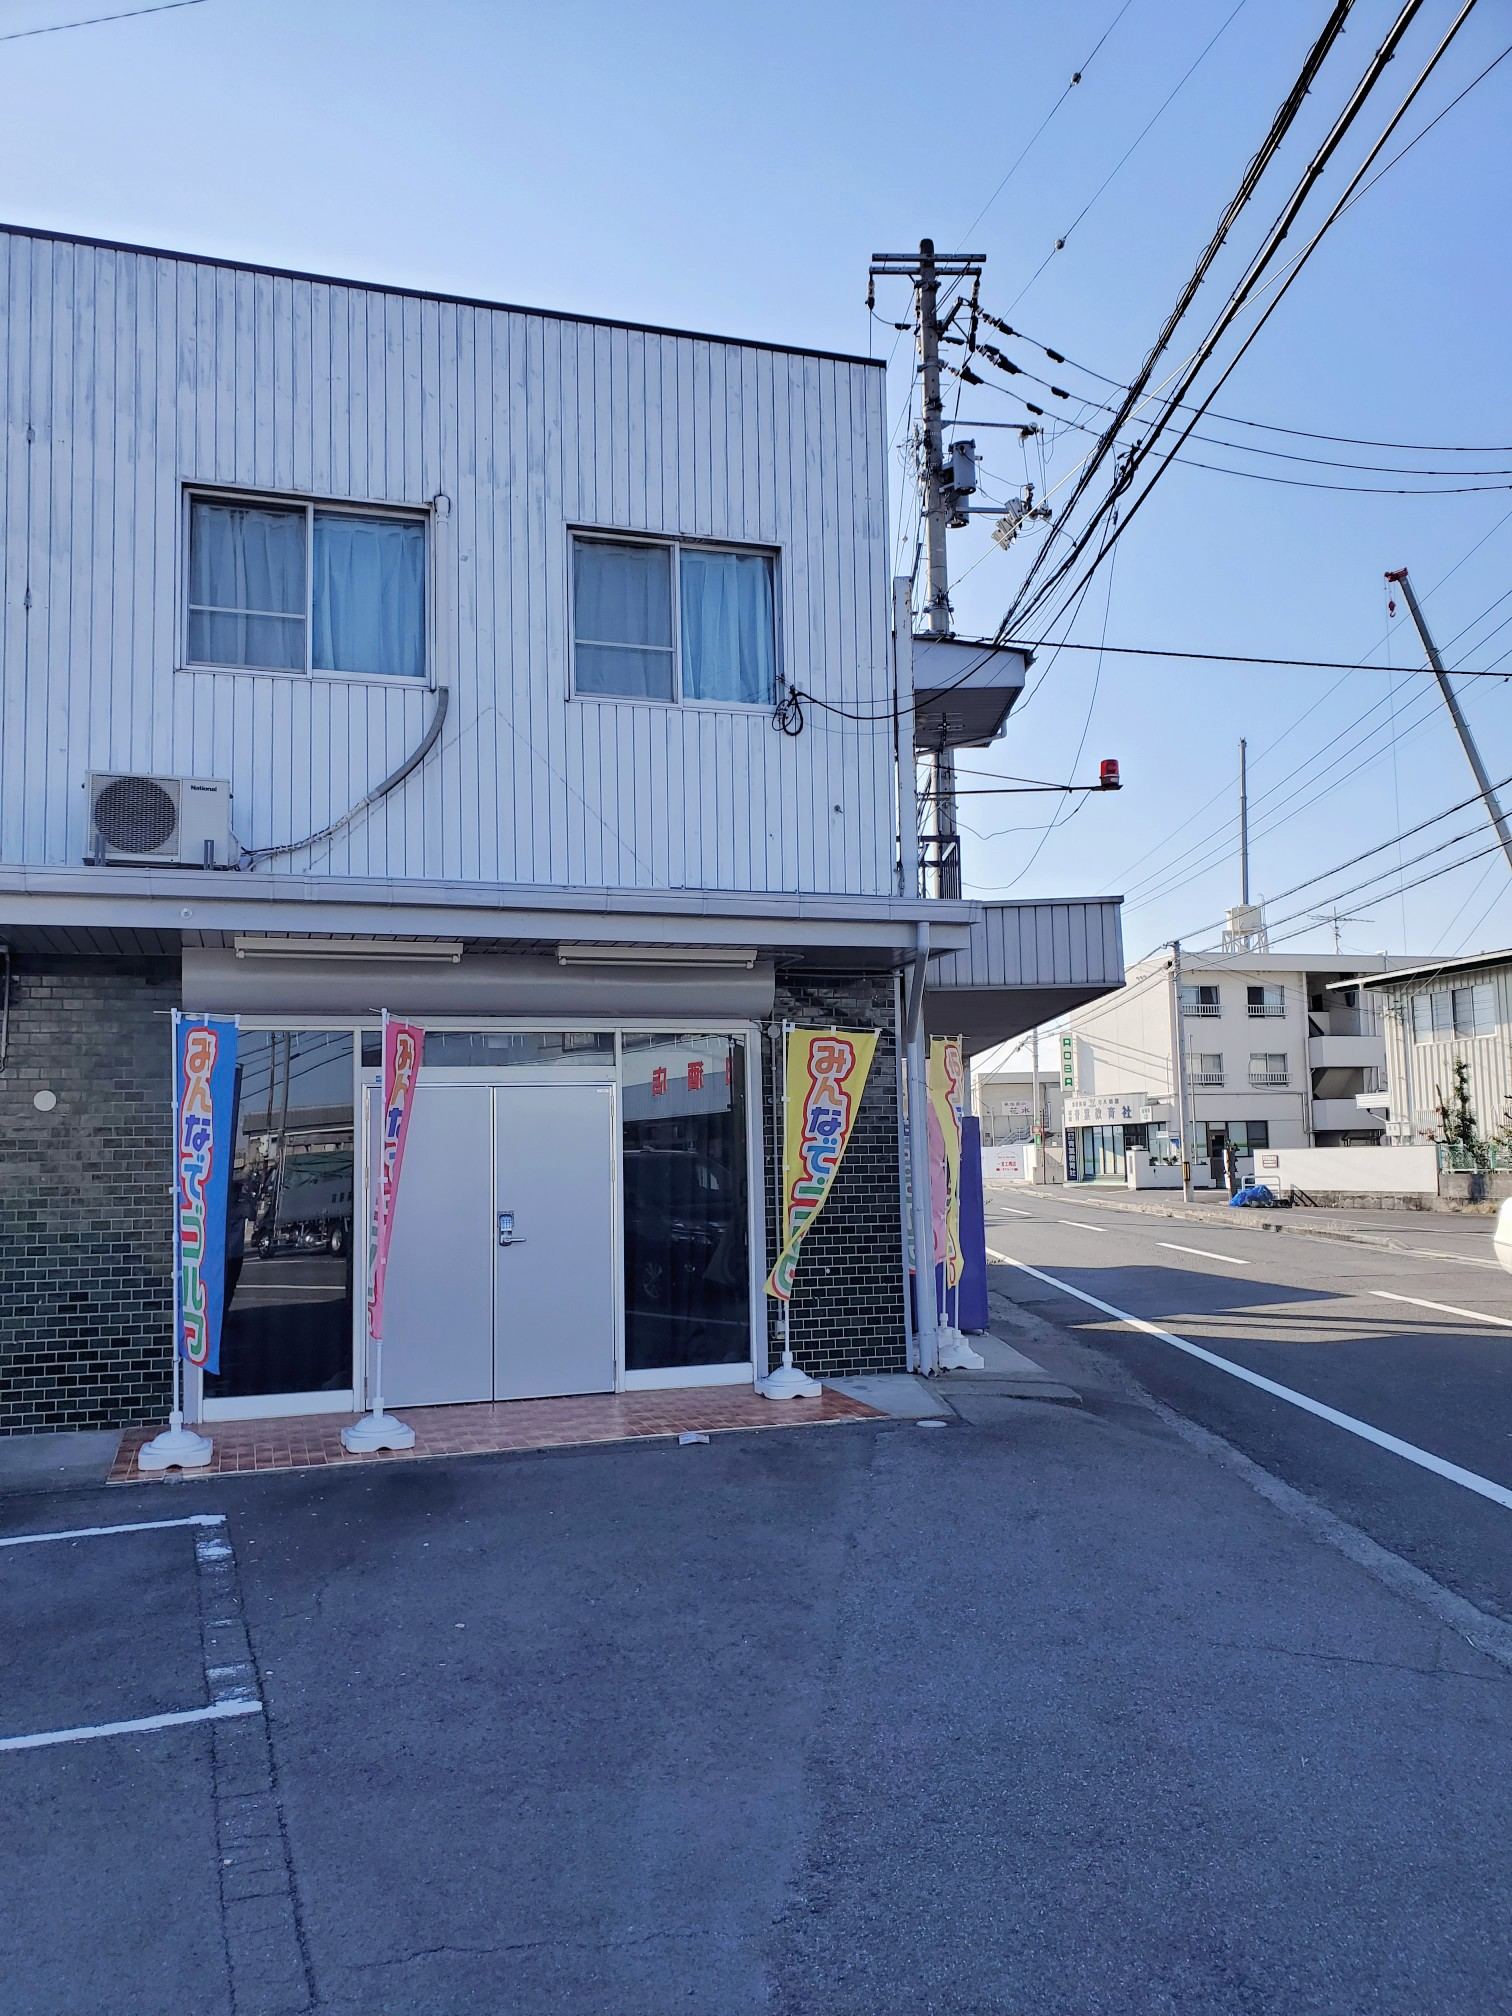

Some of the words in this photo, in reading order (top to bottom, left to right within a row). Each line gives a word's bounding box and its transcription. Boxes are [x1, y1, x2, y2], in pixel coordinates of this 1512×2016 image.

[182, 1036, 211, 1355] みんなでゴルフ
